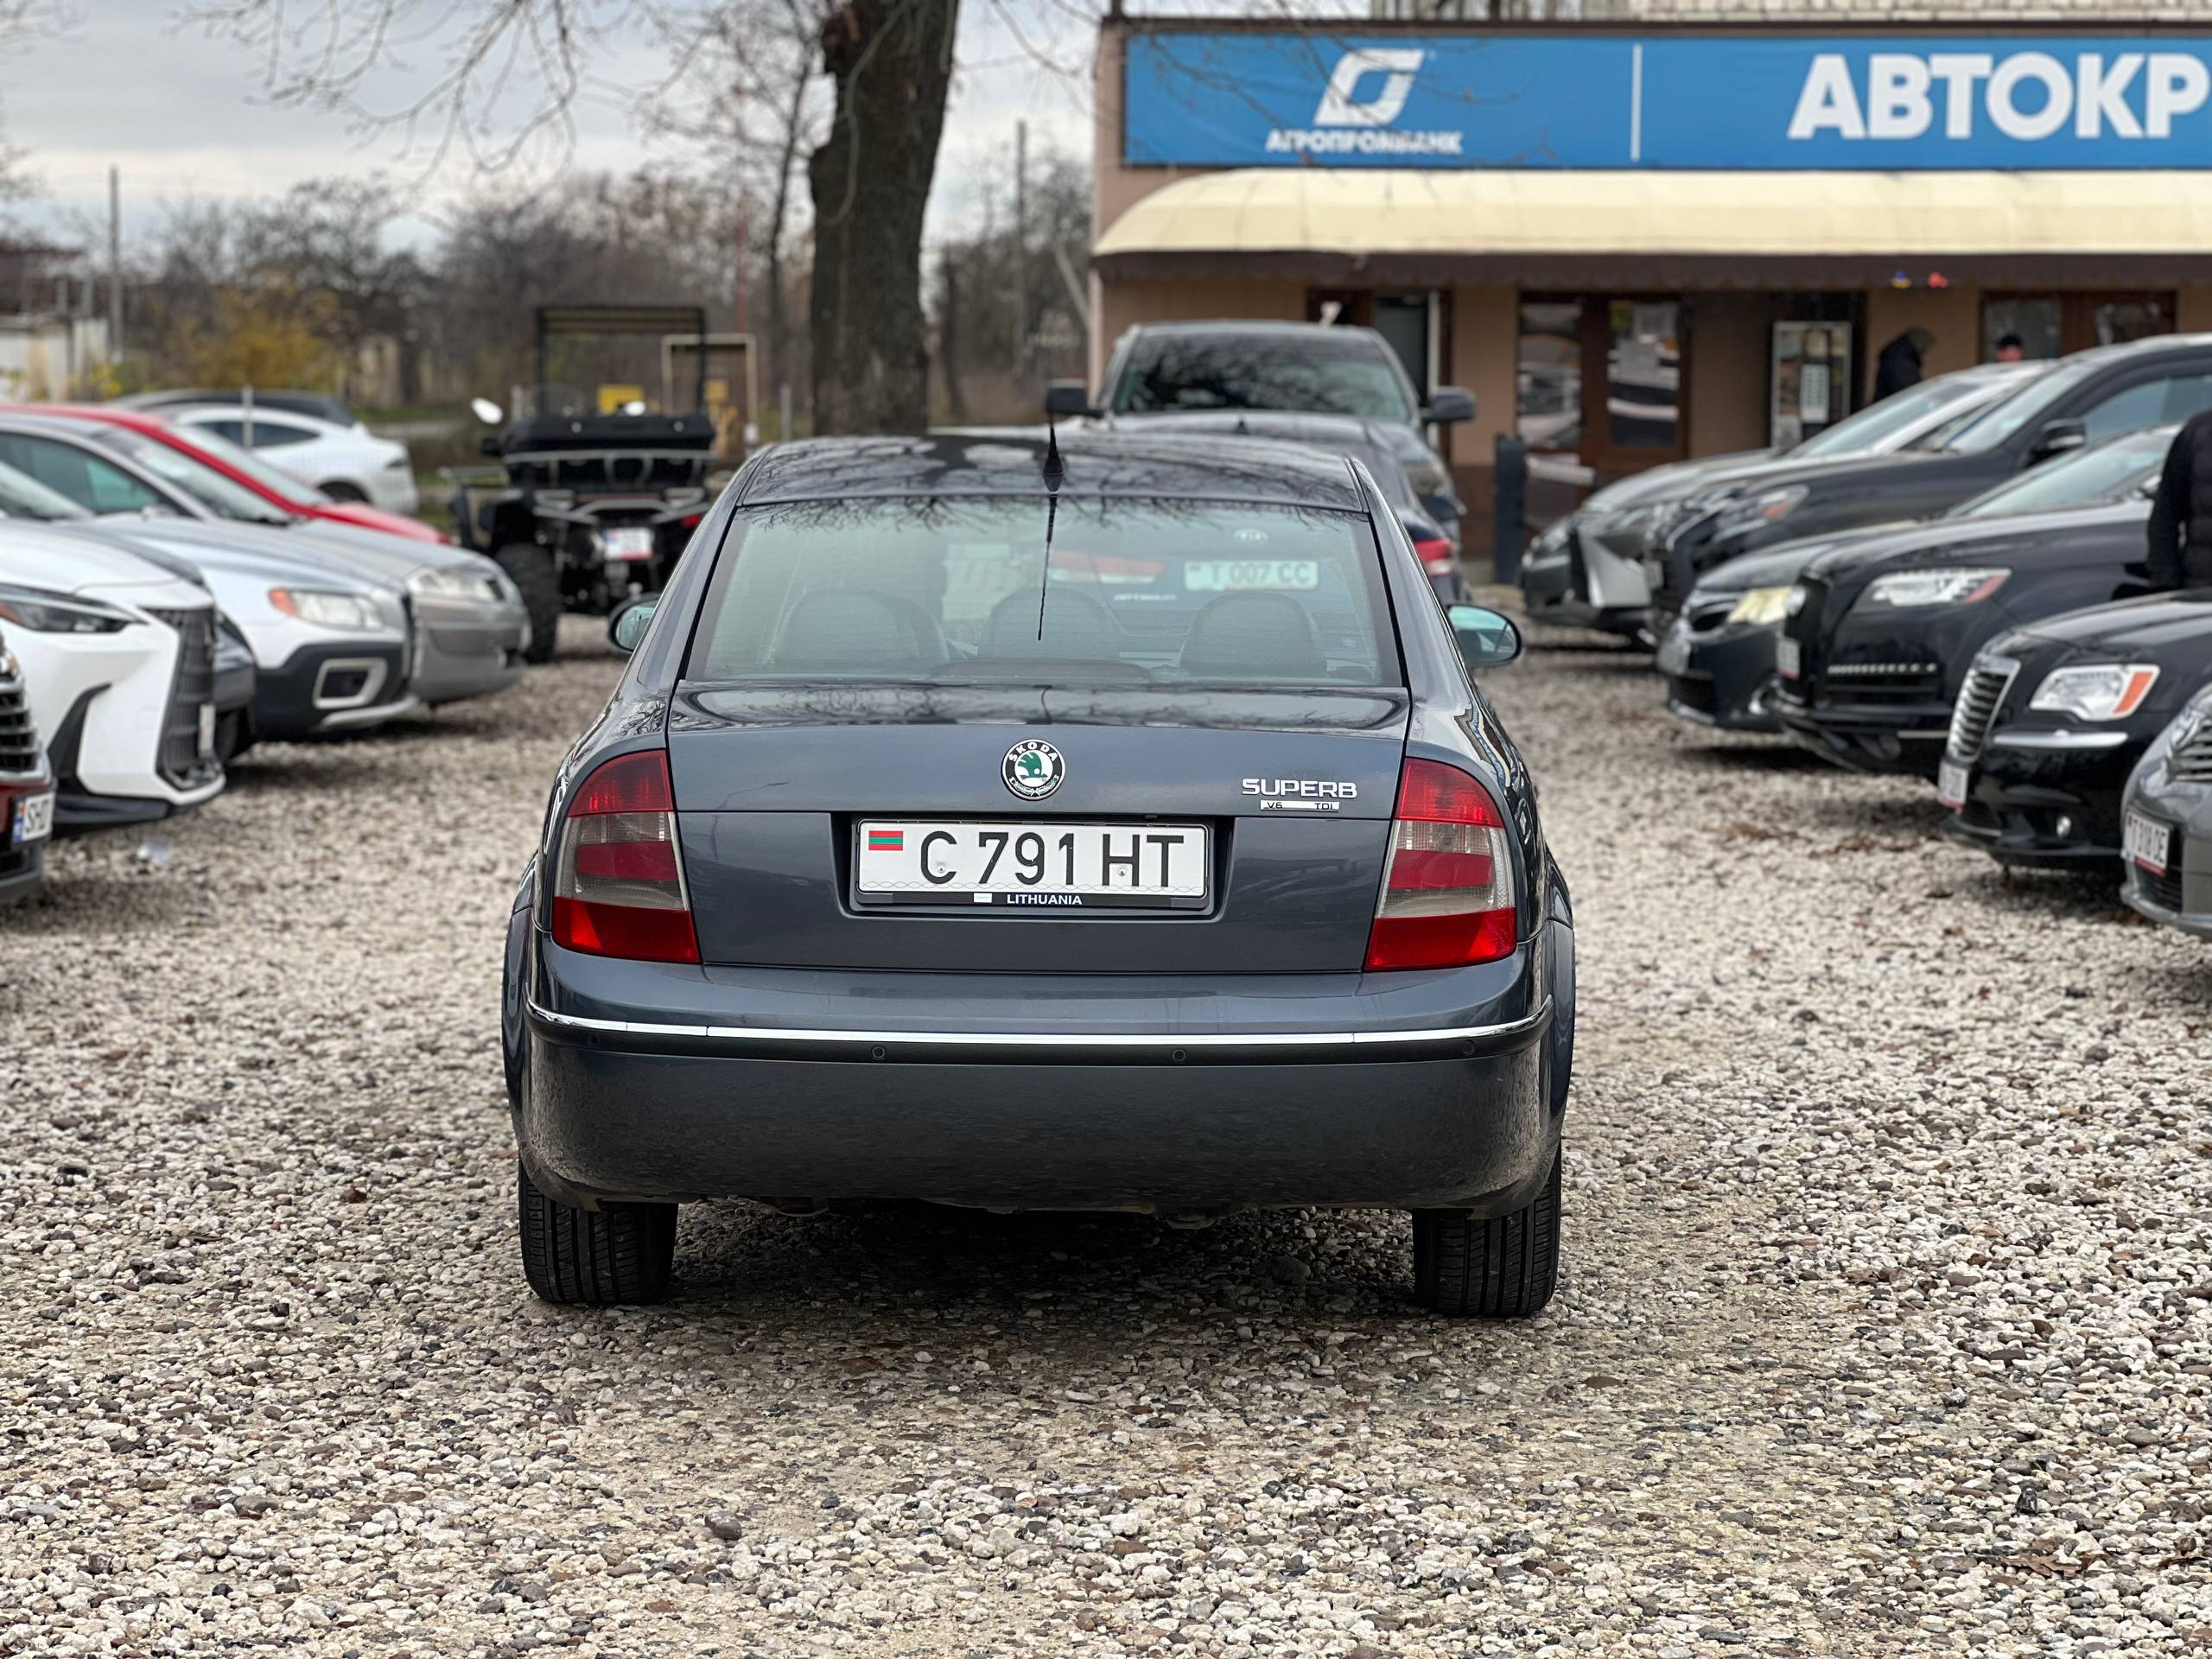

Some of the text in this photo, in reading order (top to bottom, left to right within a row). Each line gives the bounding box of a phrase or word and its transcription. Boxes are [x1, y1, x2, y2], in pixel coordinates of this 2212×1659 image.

[1787, 52, 2210, 140] АВТОКР
[1242, 779, 1357, 798] SUPERB
[920, 830, 1184, 887] C 791 HT
[1007, 894, 1082, 906] LITHUANIA
